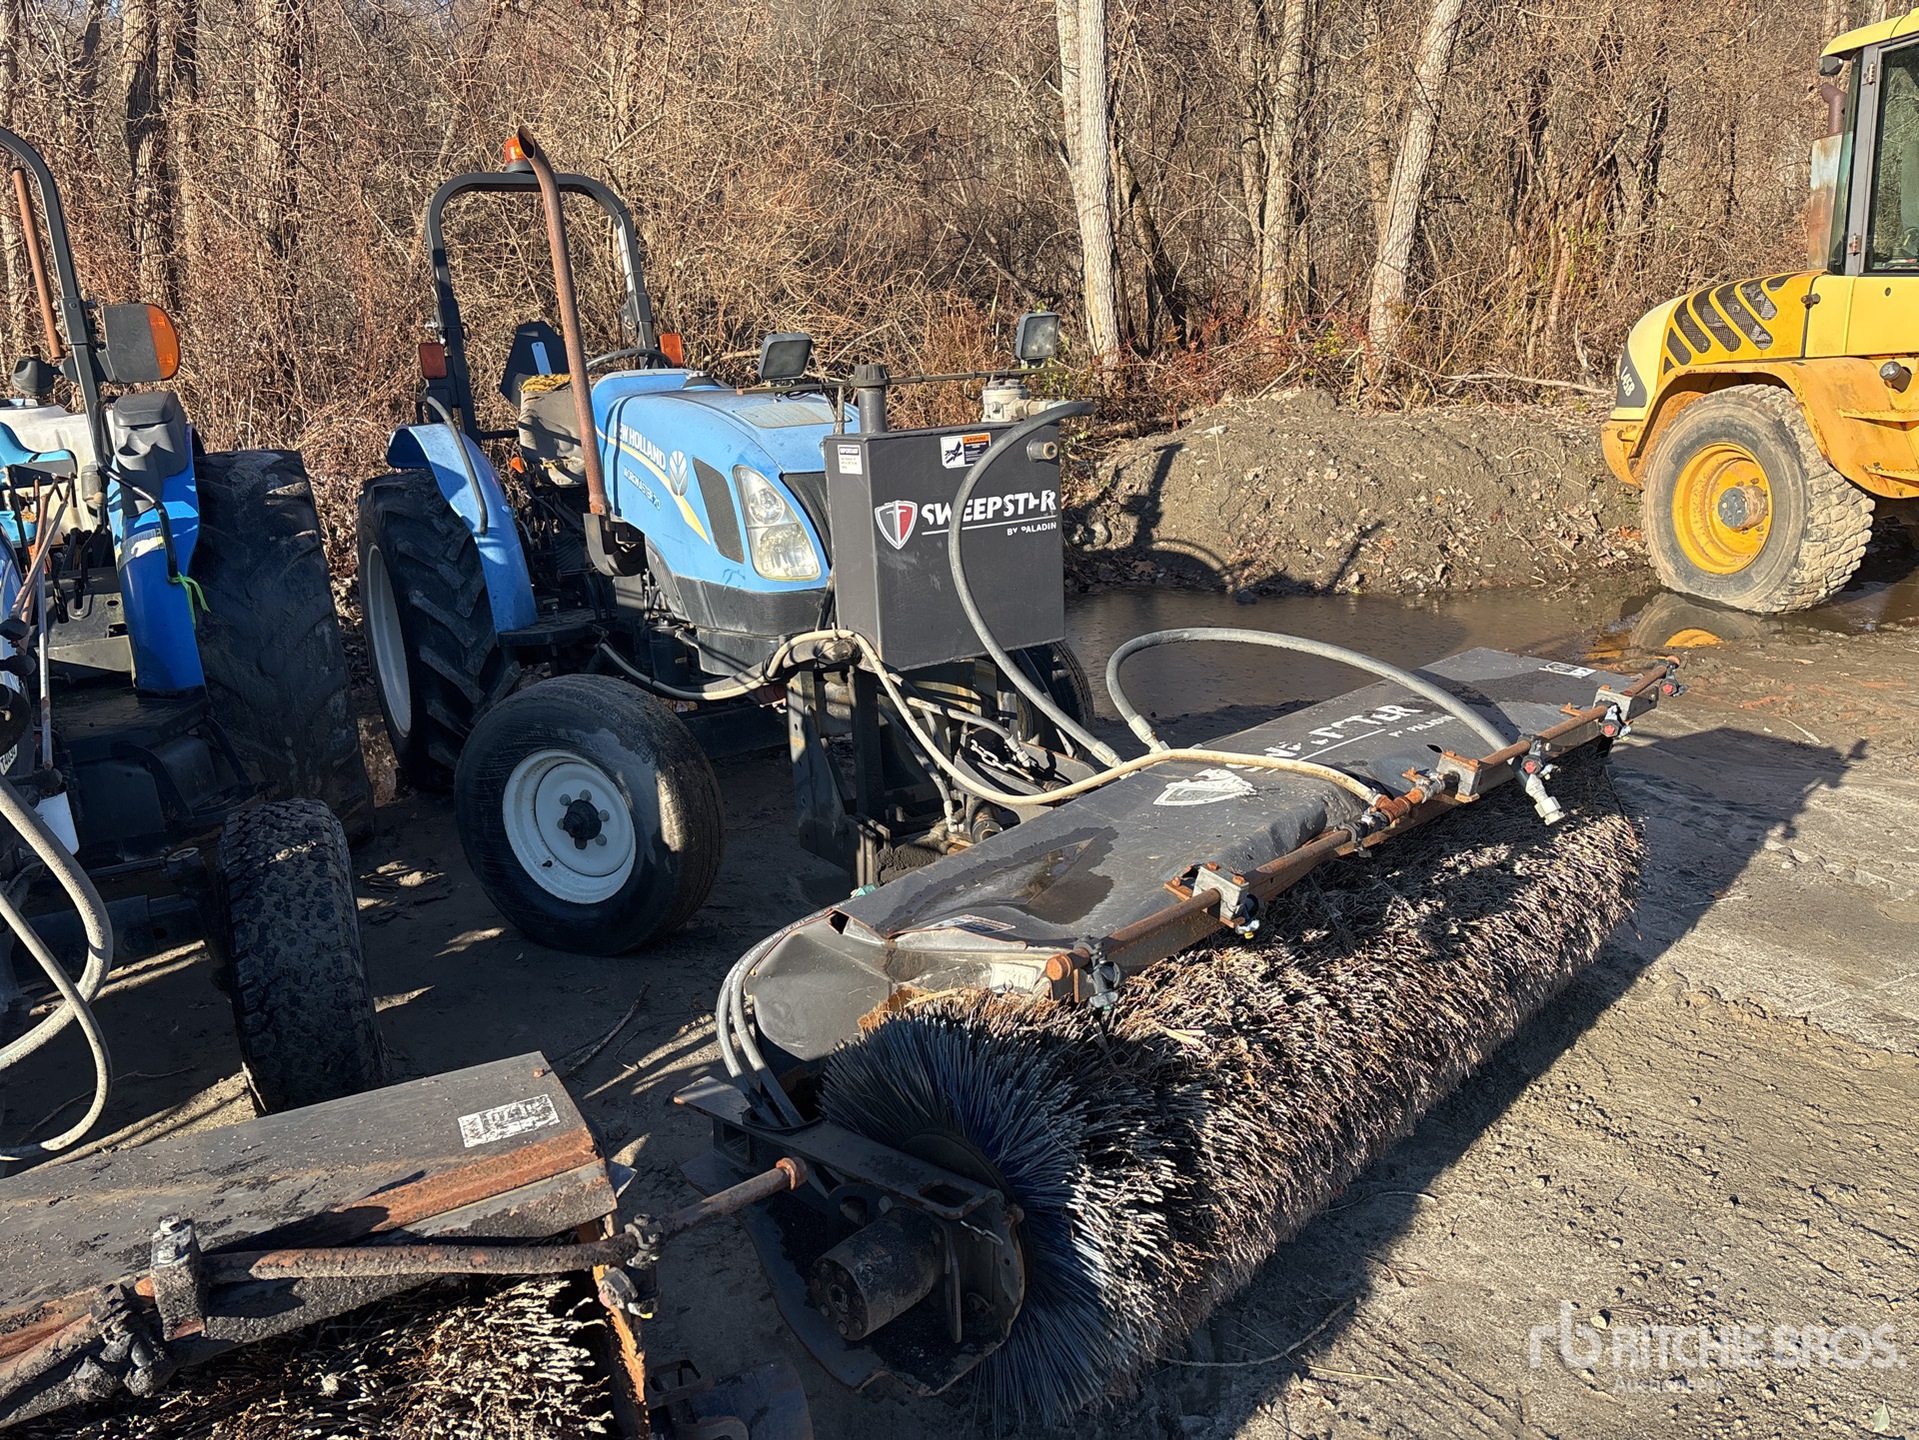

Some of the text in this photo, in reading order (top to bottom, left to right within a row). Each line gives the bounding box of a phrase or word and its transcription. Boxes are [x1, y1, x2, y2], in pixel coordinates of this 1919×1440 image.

[1621, 366, 1635, 397] L45B
[614, 420, 667, 472] NEW HOLLAND
[1007, 522, 1057, 536] BY PALADIN
